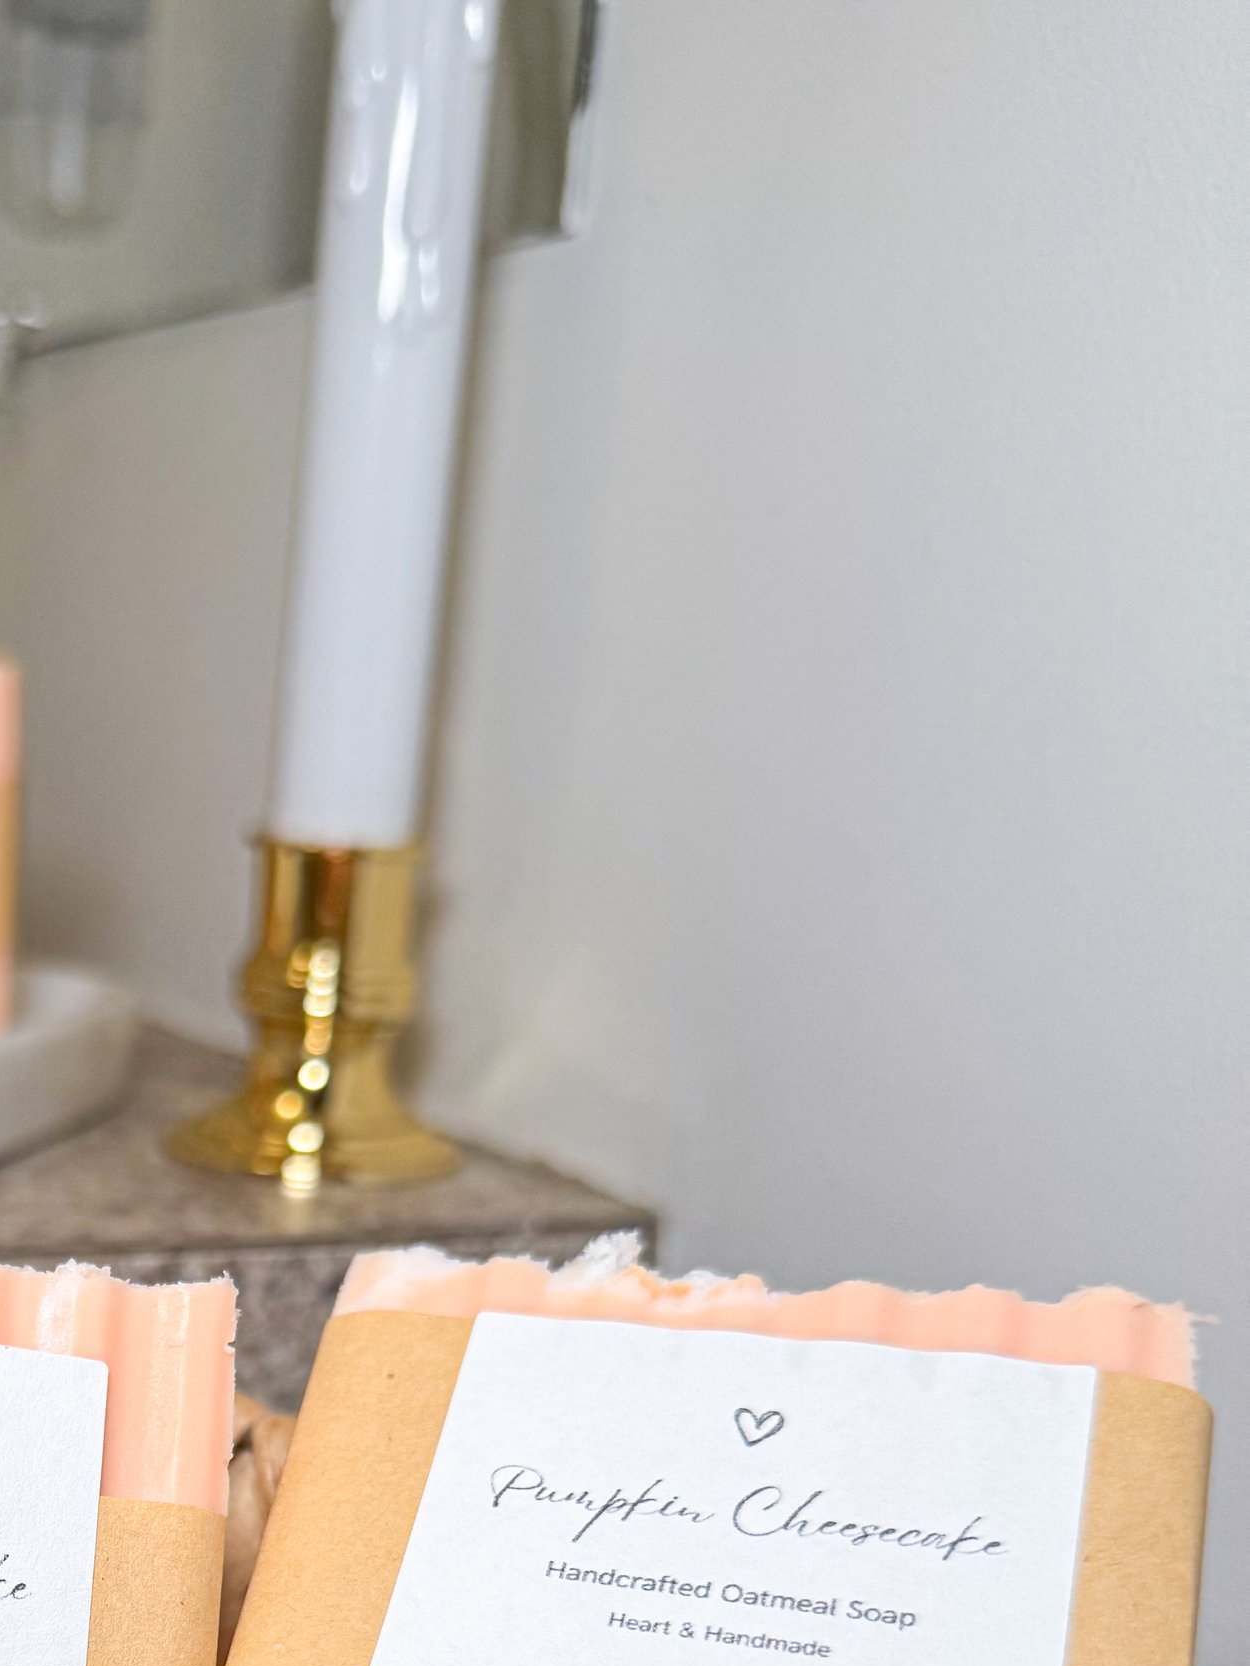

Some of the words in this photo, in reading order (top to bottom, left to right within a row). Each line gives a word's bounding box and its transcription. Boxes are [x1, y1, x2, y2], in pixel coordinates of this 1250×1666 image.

[491, 1465, 714, 1543] Pumpkin
[732, 1485, 1007, 1562] Cheesecake
[545, 1560, 712, 1599] Handcrafted
[721, 1583, 838, 1616] Oatmeal
[846, 1600, 917, 1631] Soap
[608, 1612, 671, 1635] Heart
[679, 1622, 694, 1638] &
[704, 1626, 831, 1658] Handmade
